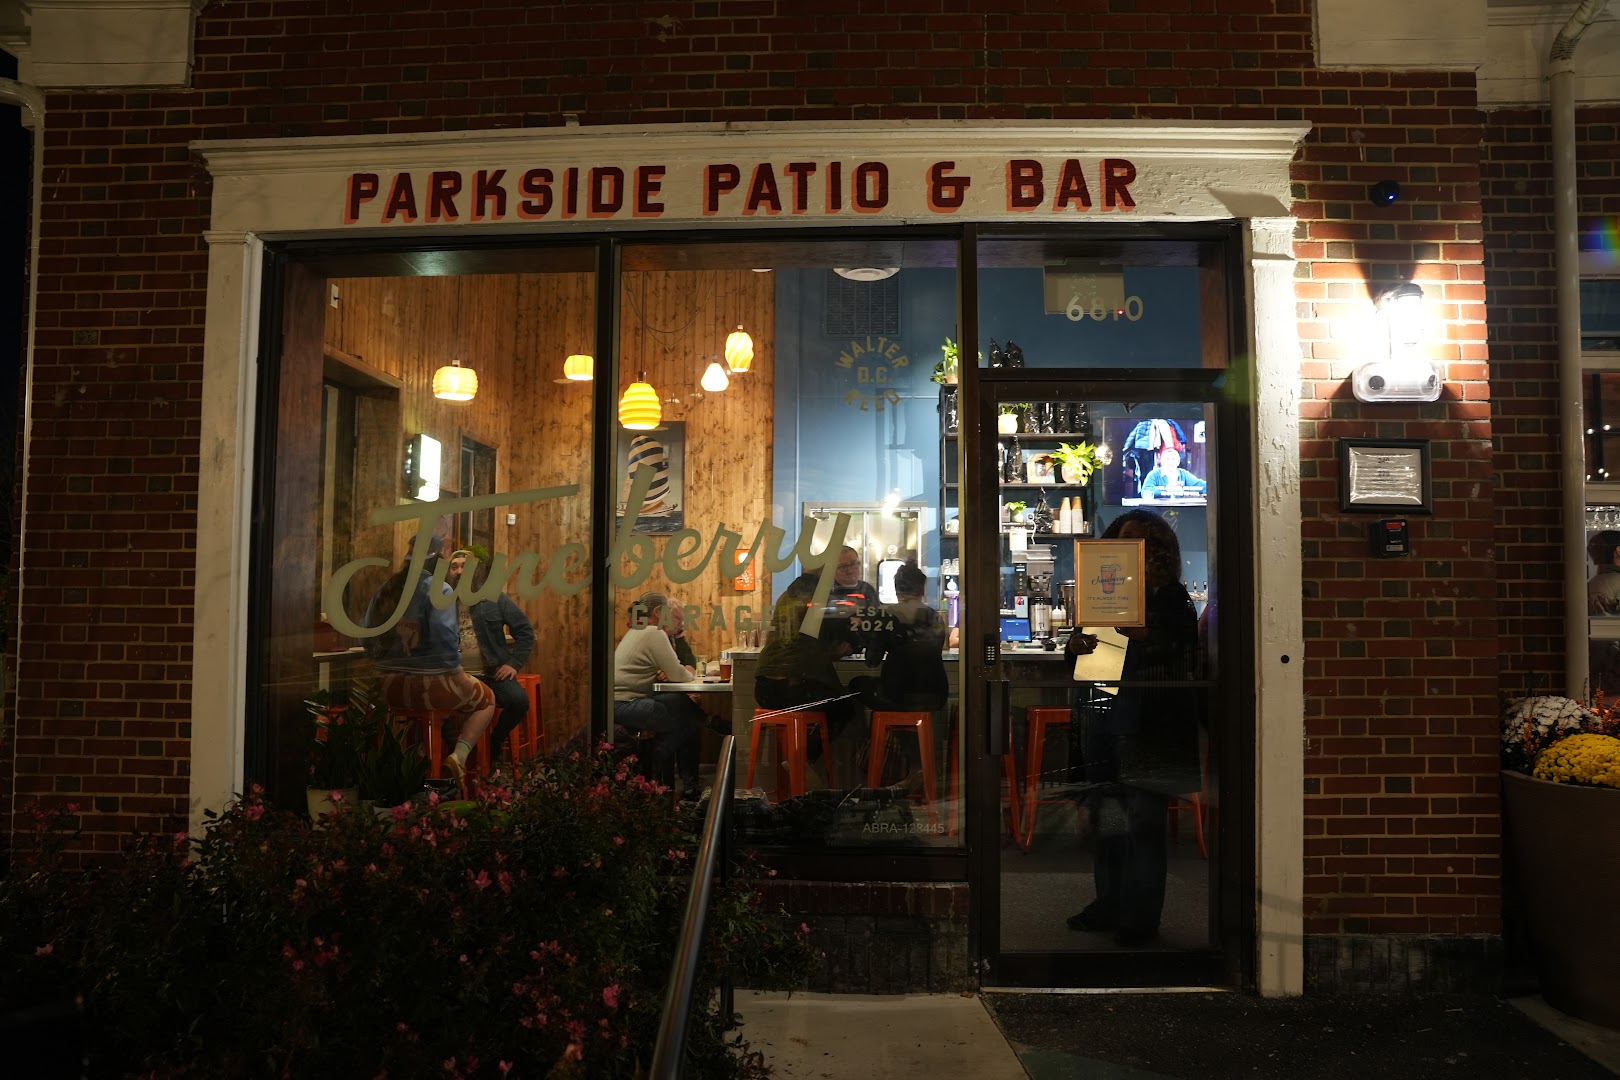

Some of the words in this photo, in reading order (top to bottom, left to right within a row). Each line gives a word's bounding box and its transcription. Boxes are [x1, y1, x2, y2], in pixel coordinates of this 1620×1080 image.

[343, 165, 666, 225] PARKSIDE
[702, 162, 889, 216] PATIO
[925, 160, 971, 214] &
[1005, 158, 1137, 214] BAR
[1066, 295, 1143, 321] 6810
[834, 336, 910, 369] WALTER
[321, 463, 851, 639] Juneberry
[631, 604, 776, 632] GARAGE
[856, 605, 893, 617] EST.
[850, 620, 895, 632] 2024
[862, 822, 945, 834] ABRA-128445
